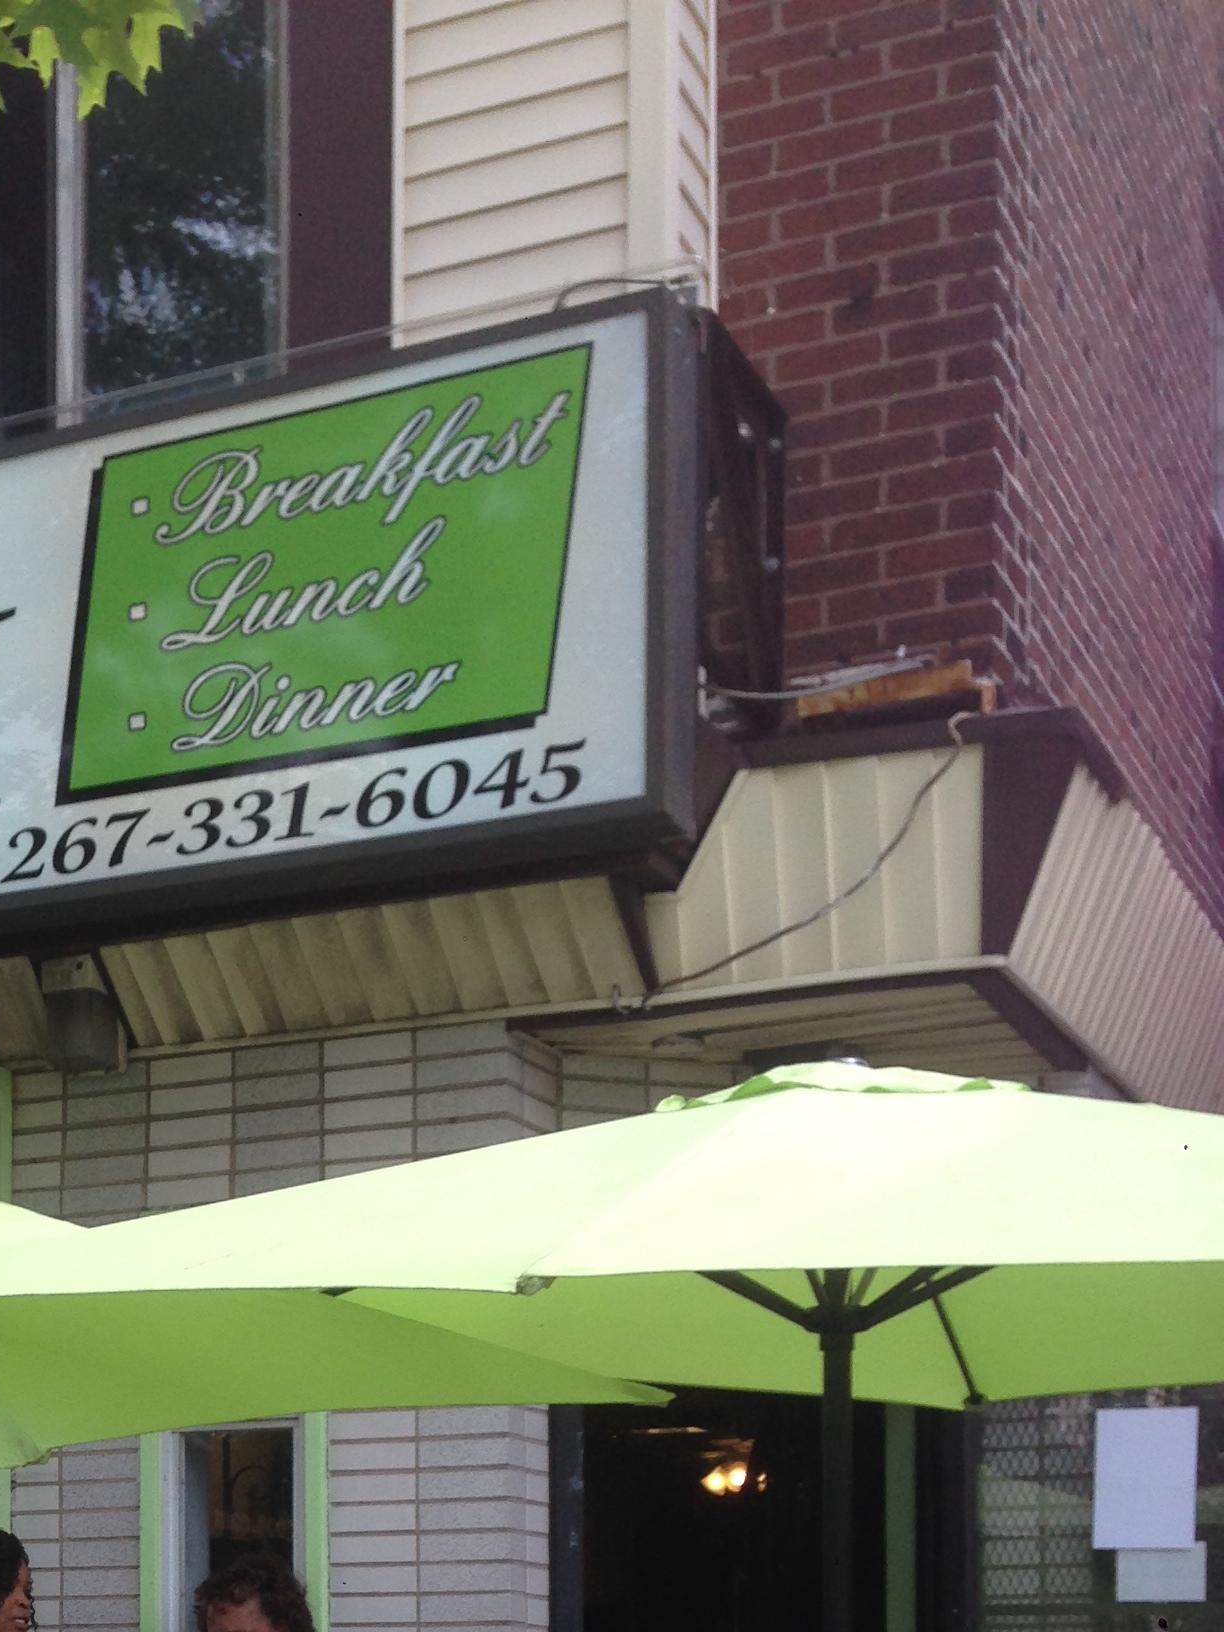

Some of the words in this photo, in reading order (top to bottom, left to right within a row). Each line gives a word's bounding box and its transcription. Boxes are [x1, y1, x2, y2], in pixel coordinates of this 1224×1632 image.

[154, 391, 571, 544] Breakfast
[161, 517, 445, 652] Lunch
[171, 661, 460, 752] Dinner
[0, 739, 587, 884] 267-331-6045
